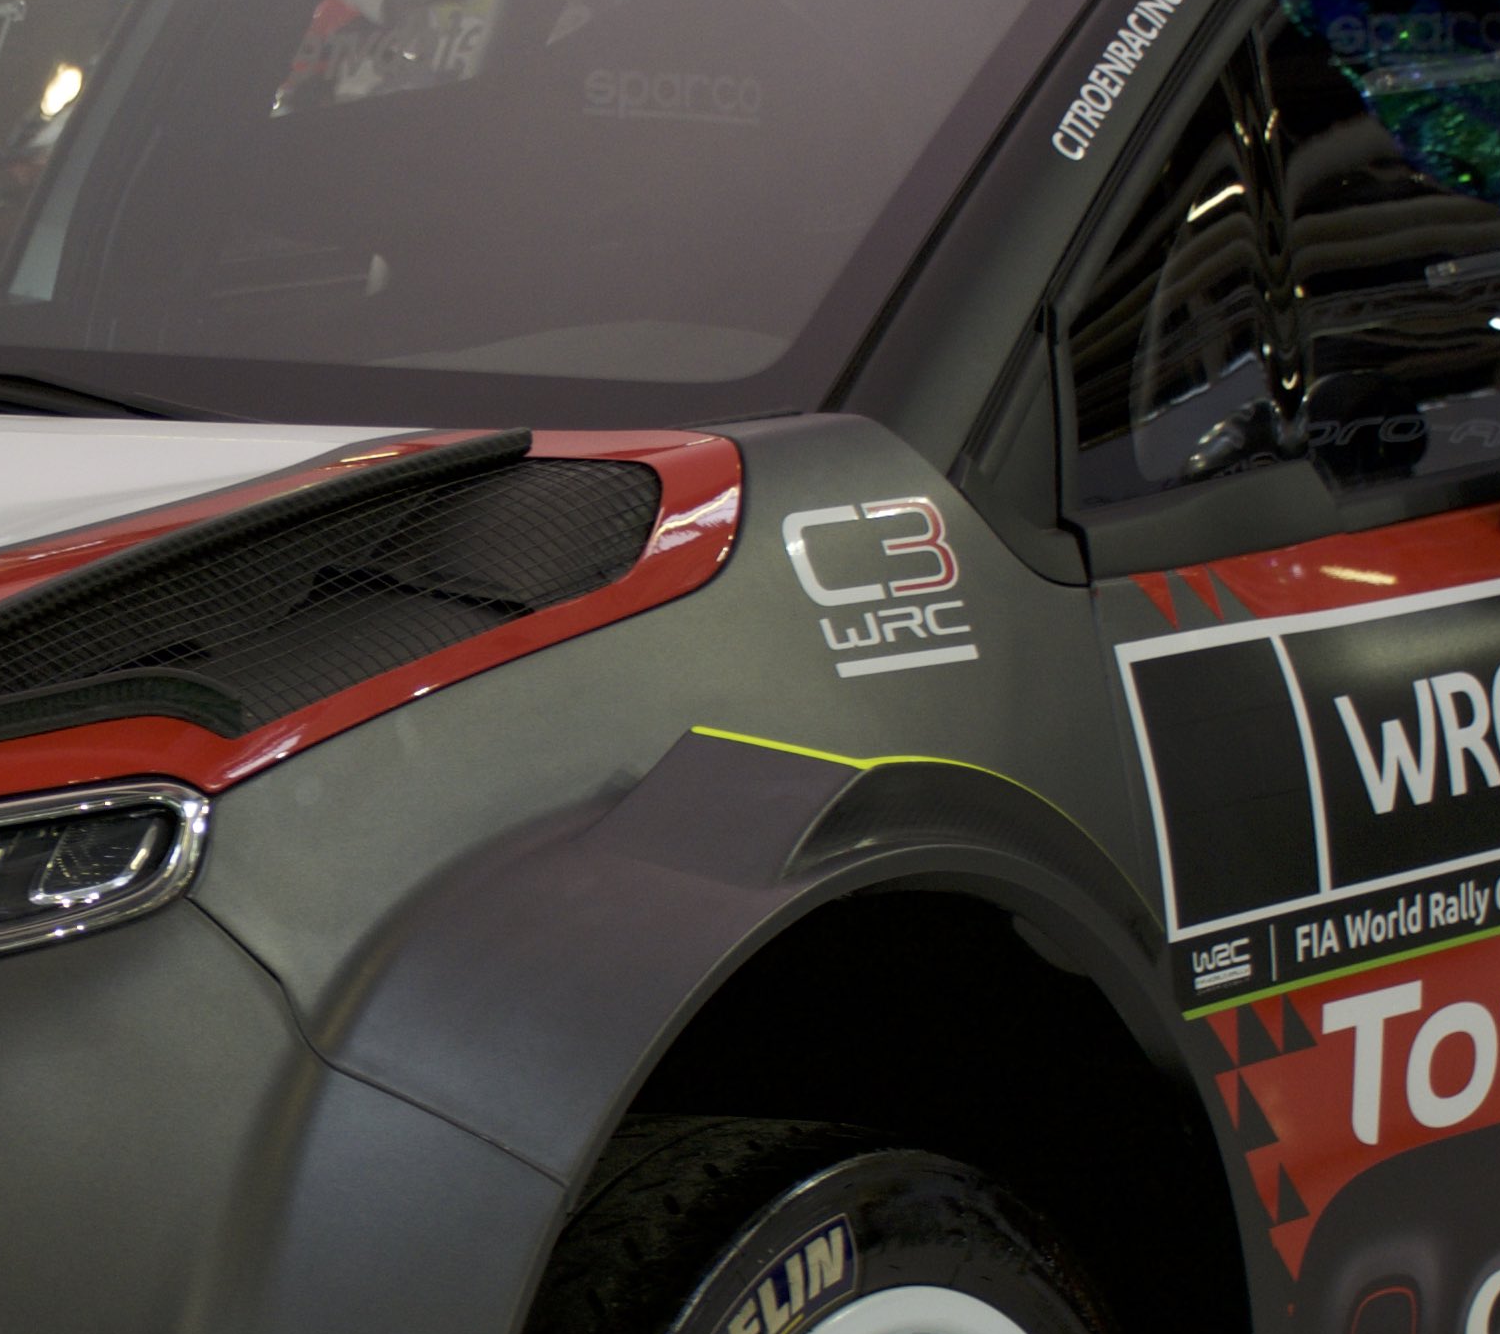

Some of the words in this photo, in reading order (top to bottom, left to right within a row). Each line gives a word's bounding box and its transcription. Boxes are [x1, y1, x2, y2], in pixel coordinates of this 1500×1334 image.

[783, 497, 960, 607] C3
[820, 600, 974, 652] WRC
[1192, 936, 1251, 973] WRC
[1295, 920, 1339, 963] FIA
[1345, 891, 1422, 950] World
[1429, 880, 1489, 929] Rally
